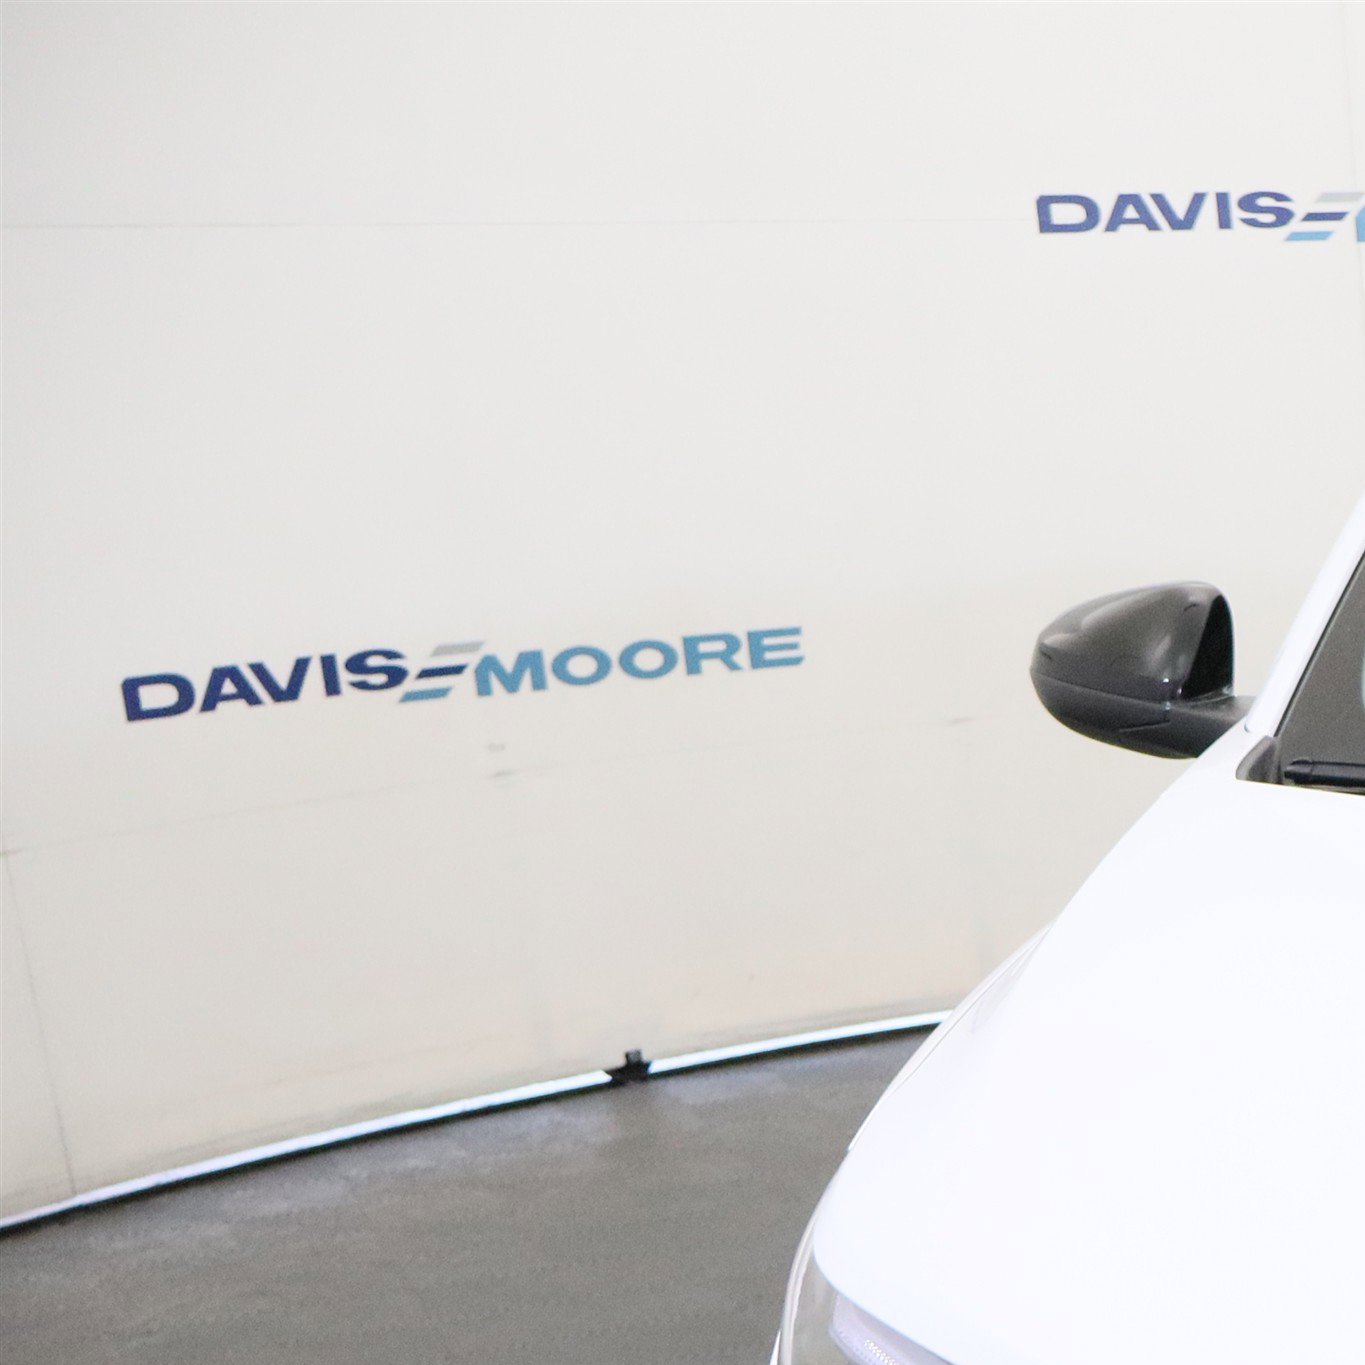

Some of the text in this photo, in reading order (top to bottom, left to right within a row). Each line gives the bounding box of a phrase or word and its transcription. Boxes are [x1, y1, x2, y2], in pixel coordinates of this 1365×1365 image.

[1037, 191, 1296, 233] DAVIS
[123, 626, 804, 721] DAVIS MOORE
